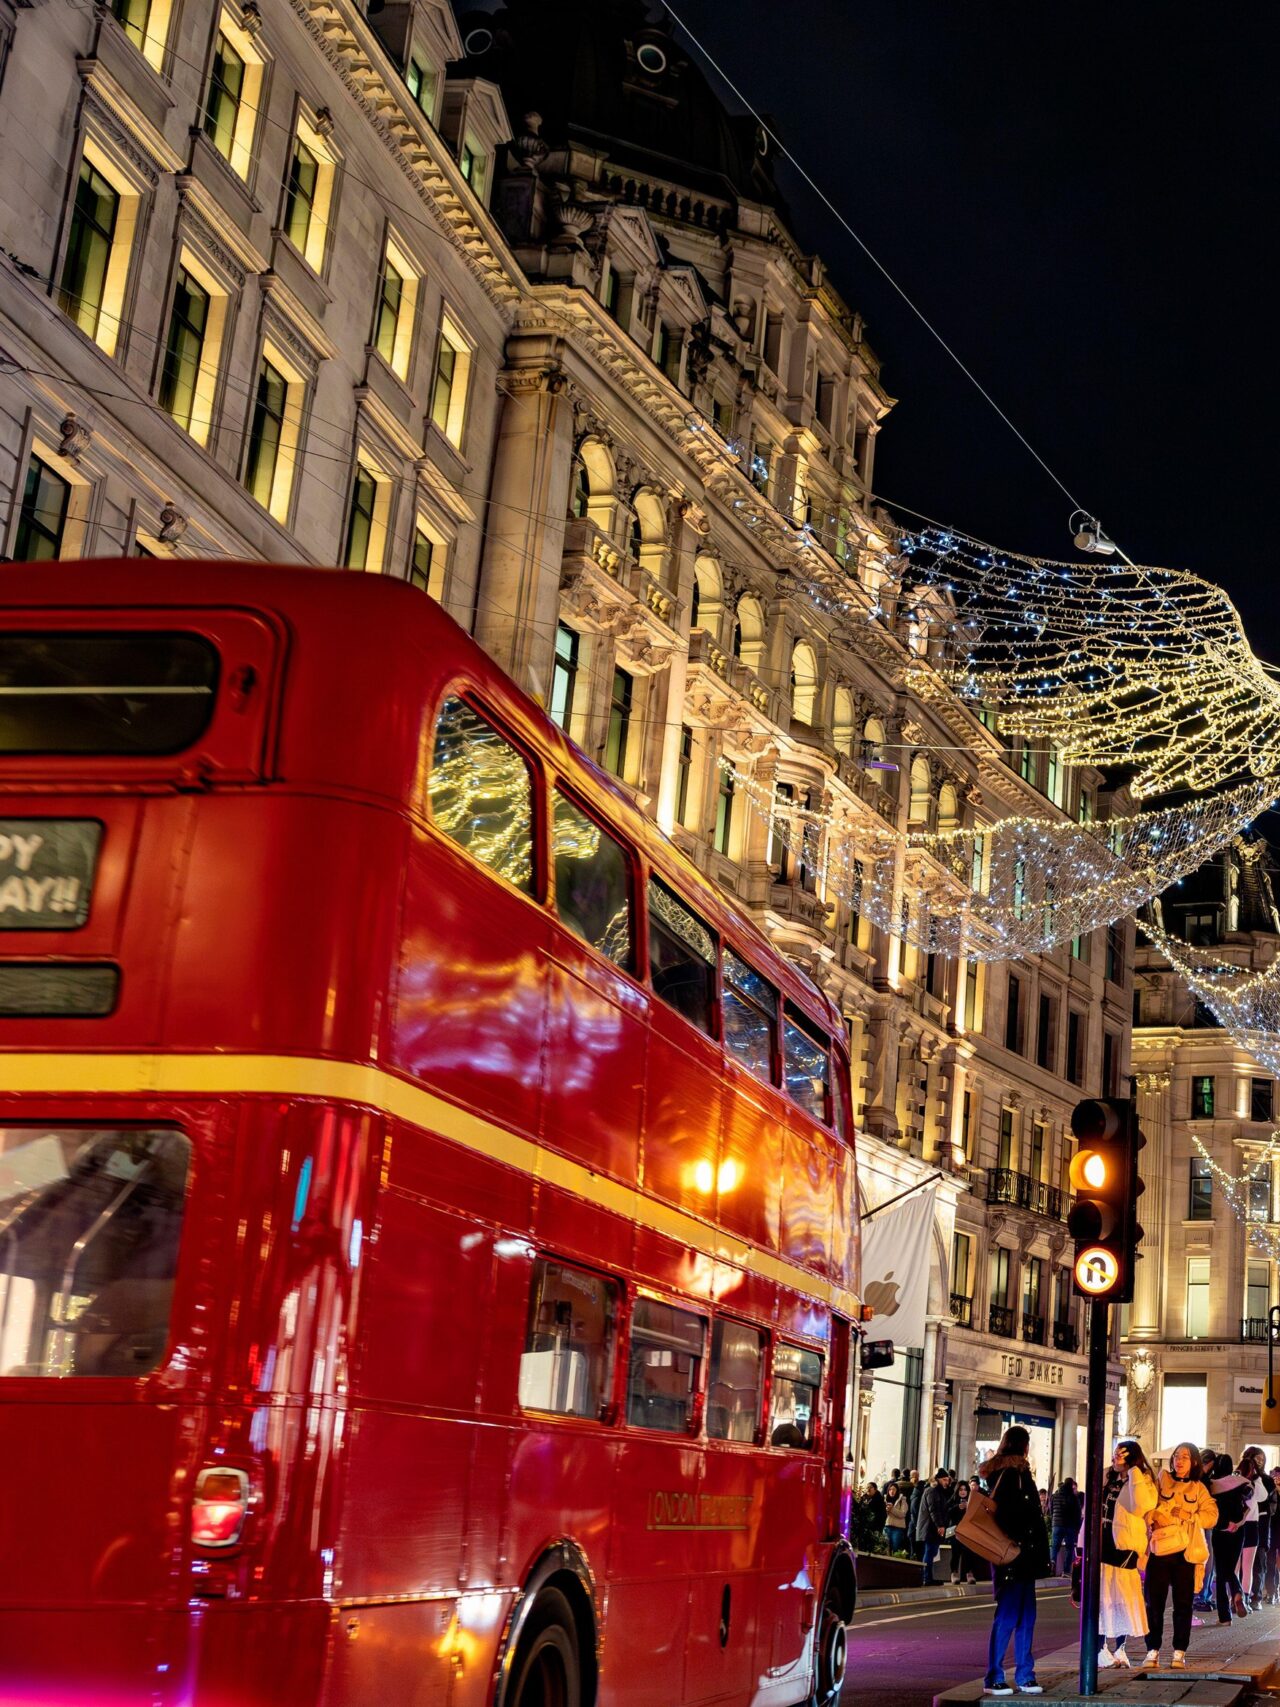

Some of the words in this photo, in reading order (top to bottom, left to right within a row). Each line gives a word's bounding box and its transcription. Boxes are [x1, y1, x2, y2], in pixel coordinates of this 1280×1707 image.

[1001, 1354, 1023, 1378] TED
[1029, 1361, 1064, 1385] BAKER
[647, 1491, 698, 1524] LONDON
